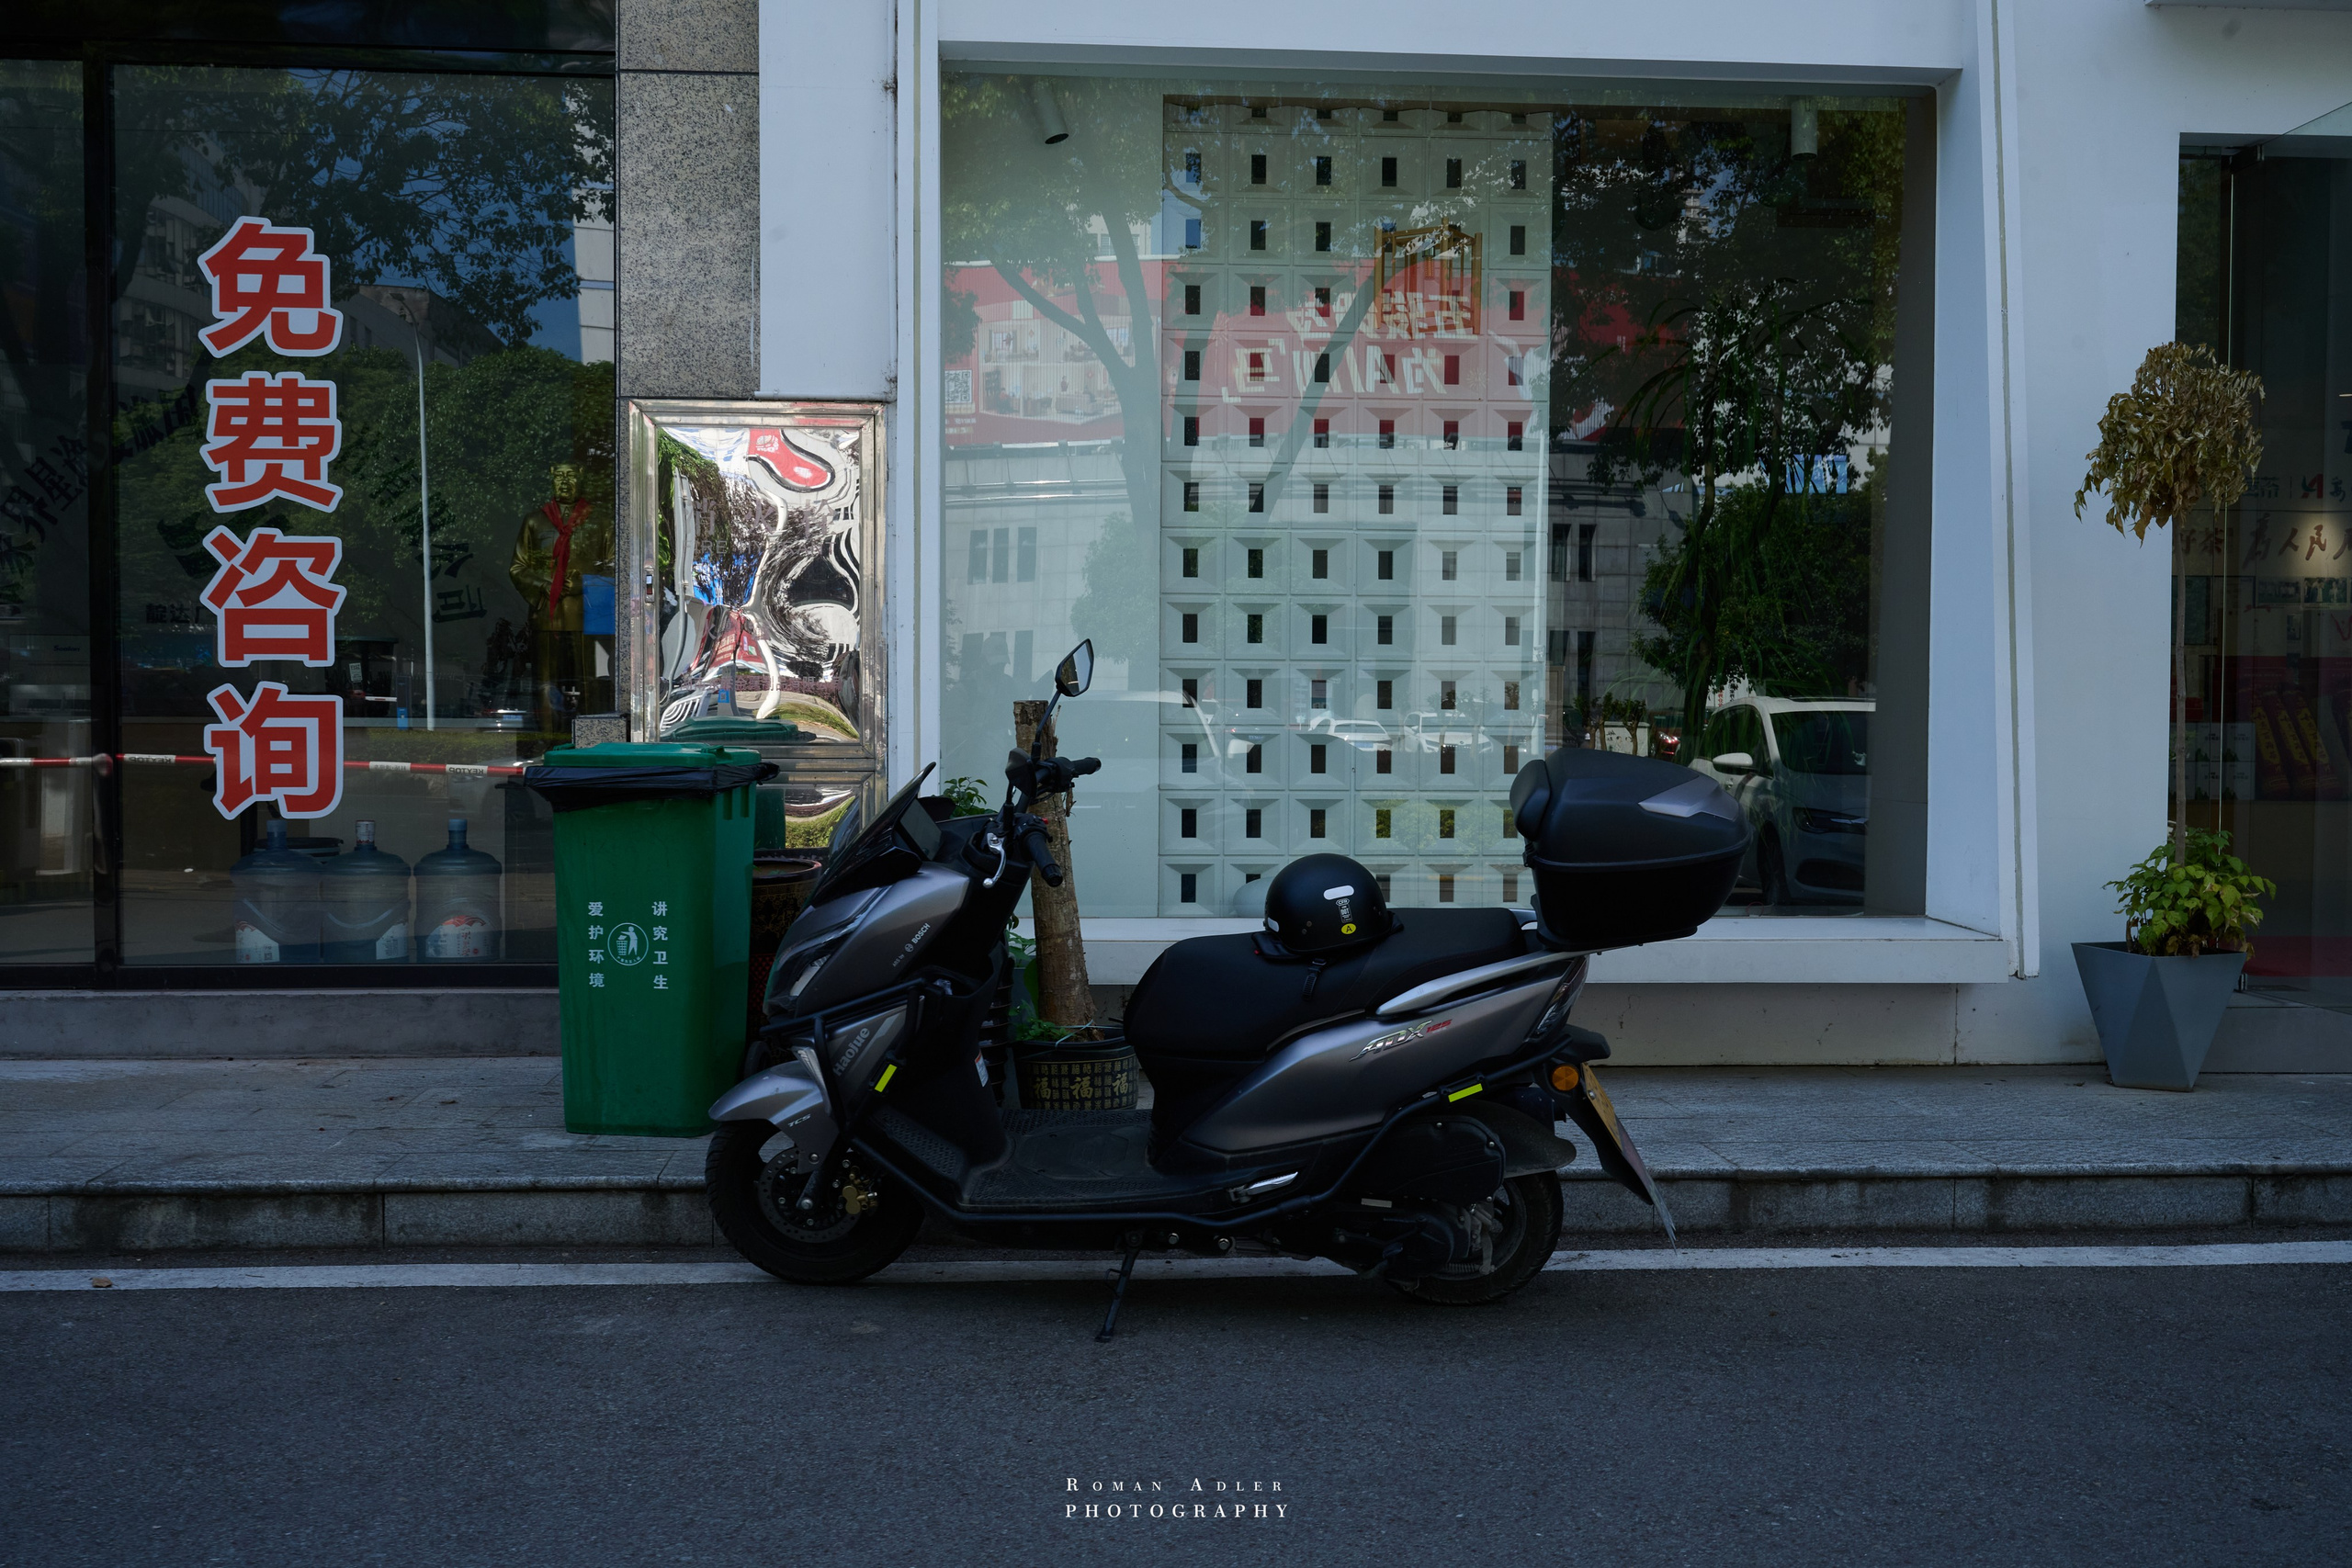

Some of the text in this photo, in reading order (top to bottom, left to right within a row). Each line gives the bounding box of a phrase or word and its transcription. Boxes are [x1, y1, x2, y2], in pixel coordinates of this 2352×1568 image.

[199, 217, 346, 819] 免费咨询
[588, 901, 605, 987] 爱护环境
[651, 901, 669, 990] 讲究卫生
[910, 922, 931, 944] BOSCH
[1425, 1019, 1453, 1034] 125
[832, 1026, 871, 1077] Haojue
[1032, 1072, 1129, 1100] 福 福 福
[787, 1113, 812, 1128] TCS
